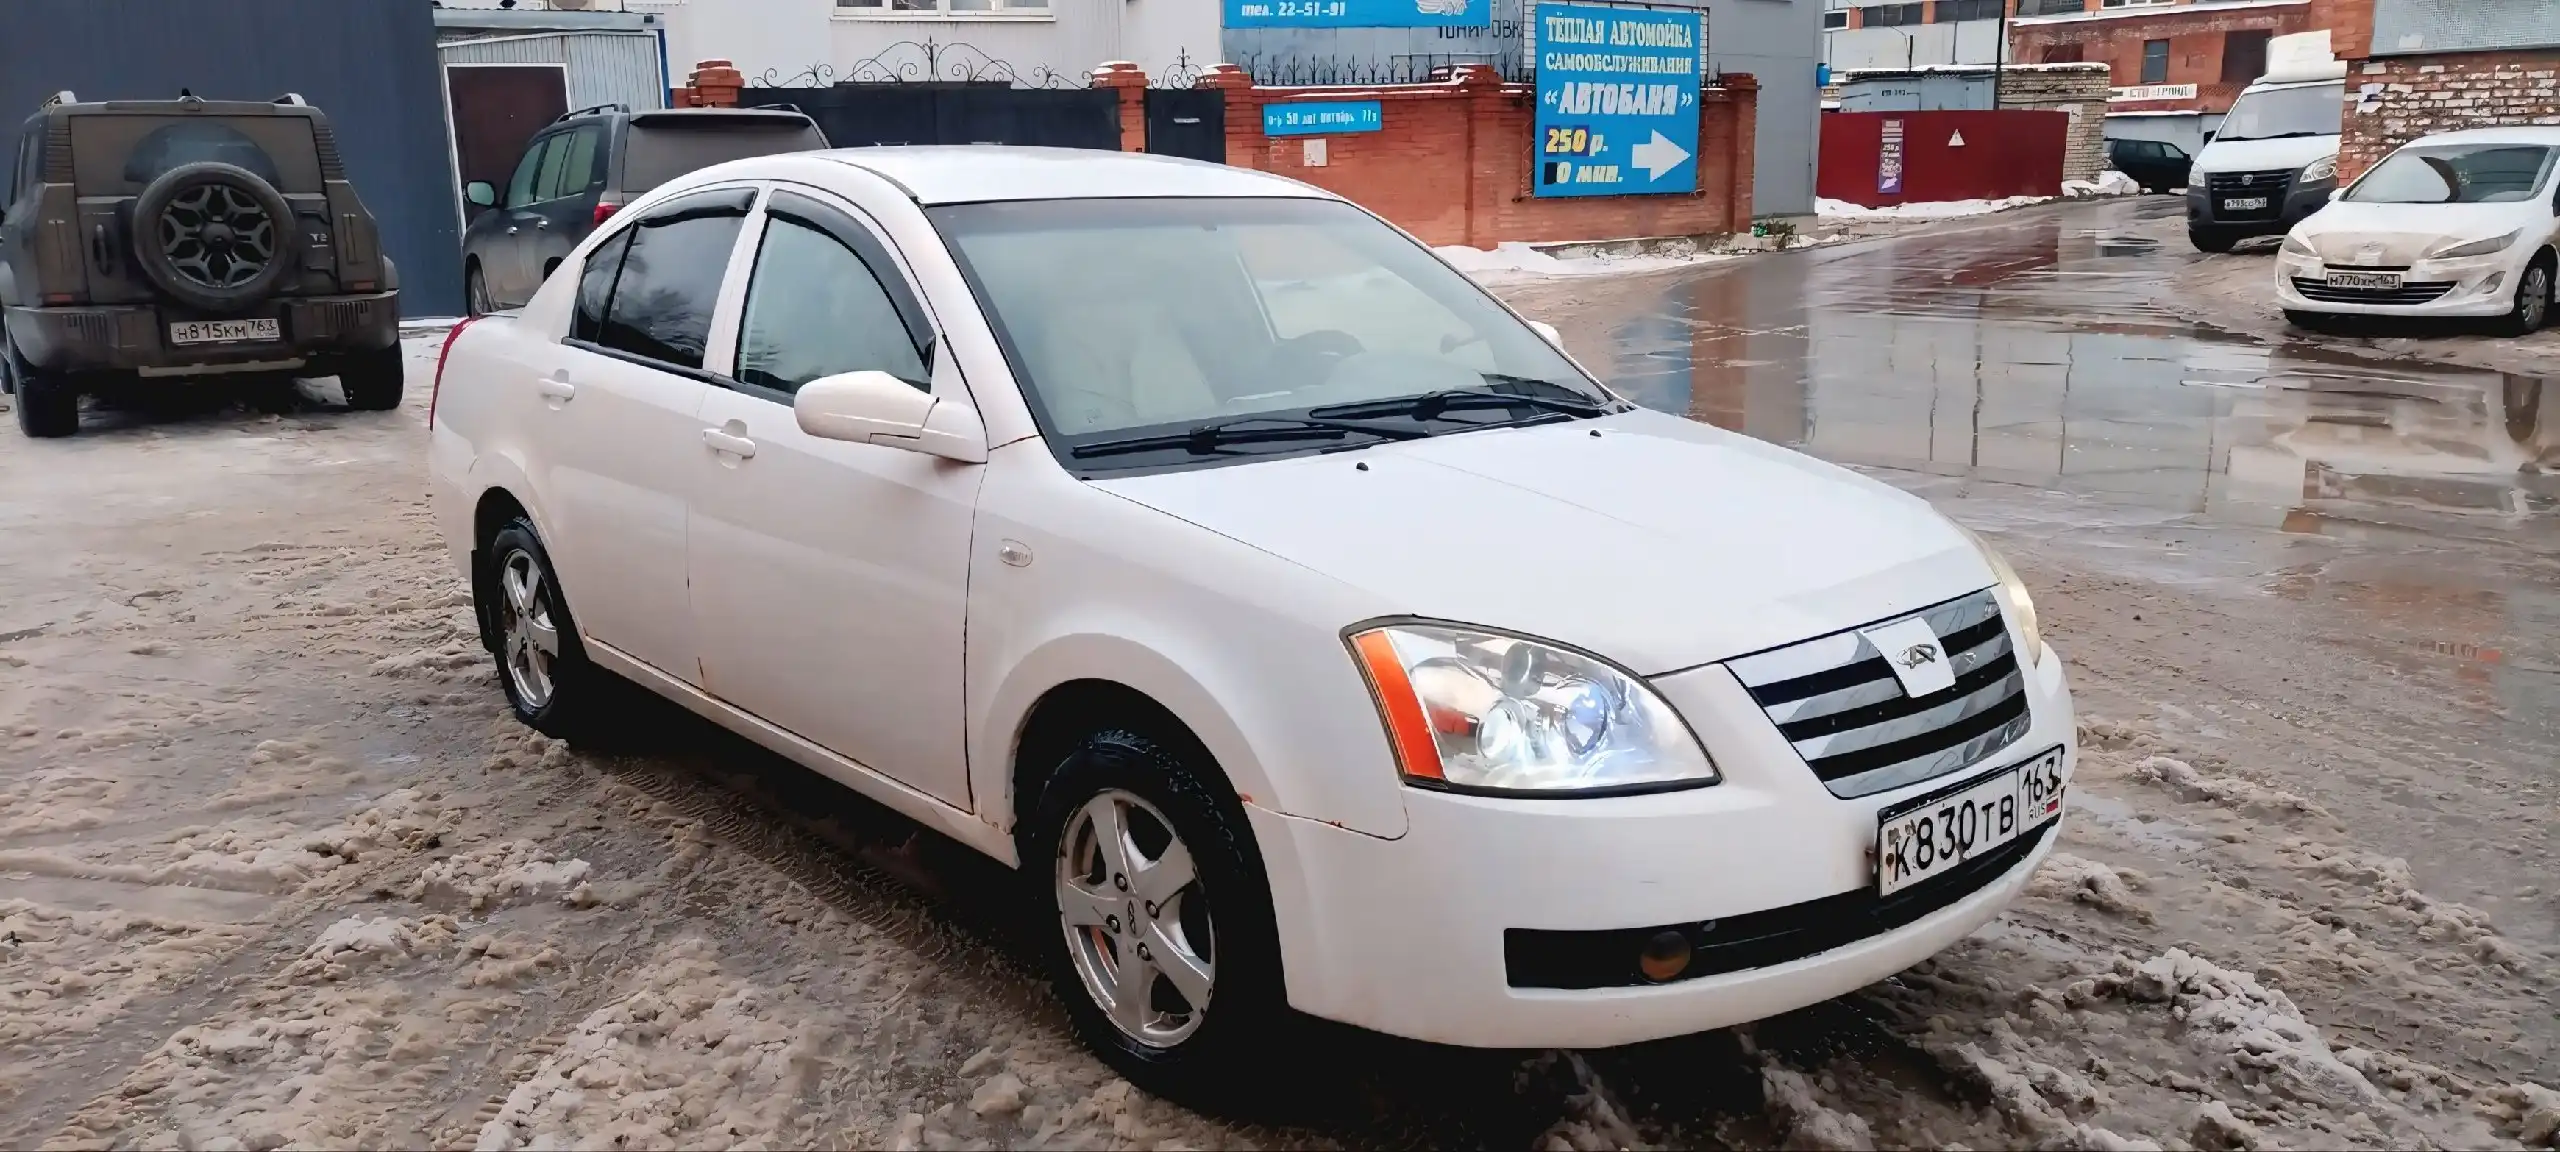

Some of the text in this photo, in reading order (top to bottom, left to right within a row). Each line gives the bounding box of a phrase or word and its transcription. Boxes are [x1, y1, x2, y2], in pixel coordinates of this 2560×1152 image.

[1546, 12, 1693, 48] ТЁПЛАЯ АВТОМОЙКА
[1545, 53, 1693, 75] САМООБСЛУЖИВАНИЯ
[1546, 129, 1609, 157] 250 р.
[1576, 165, 1624, 183] мин.
[1894, 756, 2062, 882] К830ТВ 163
